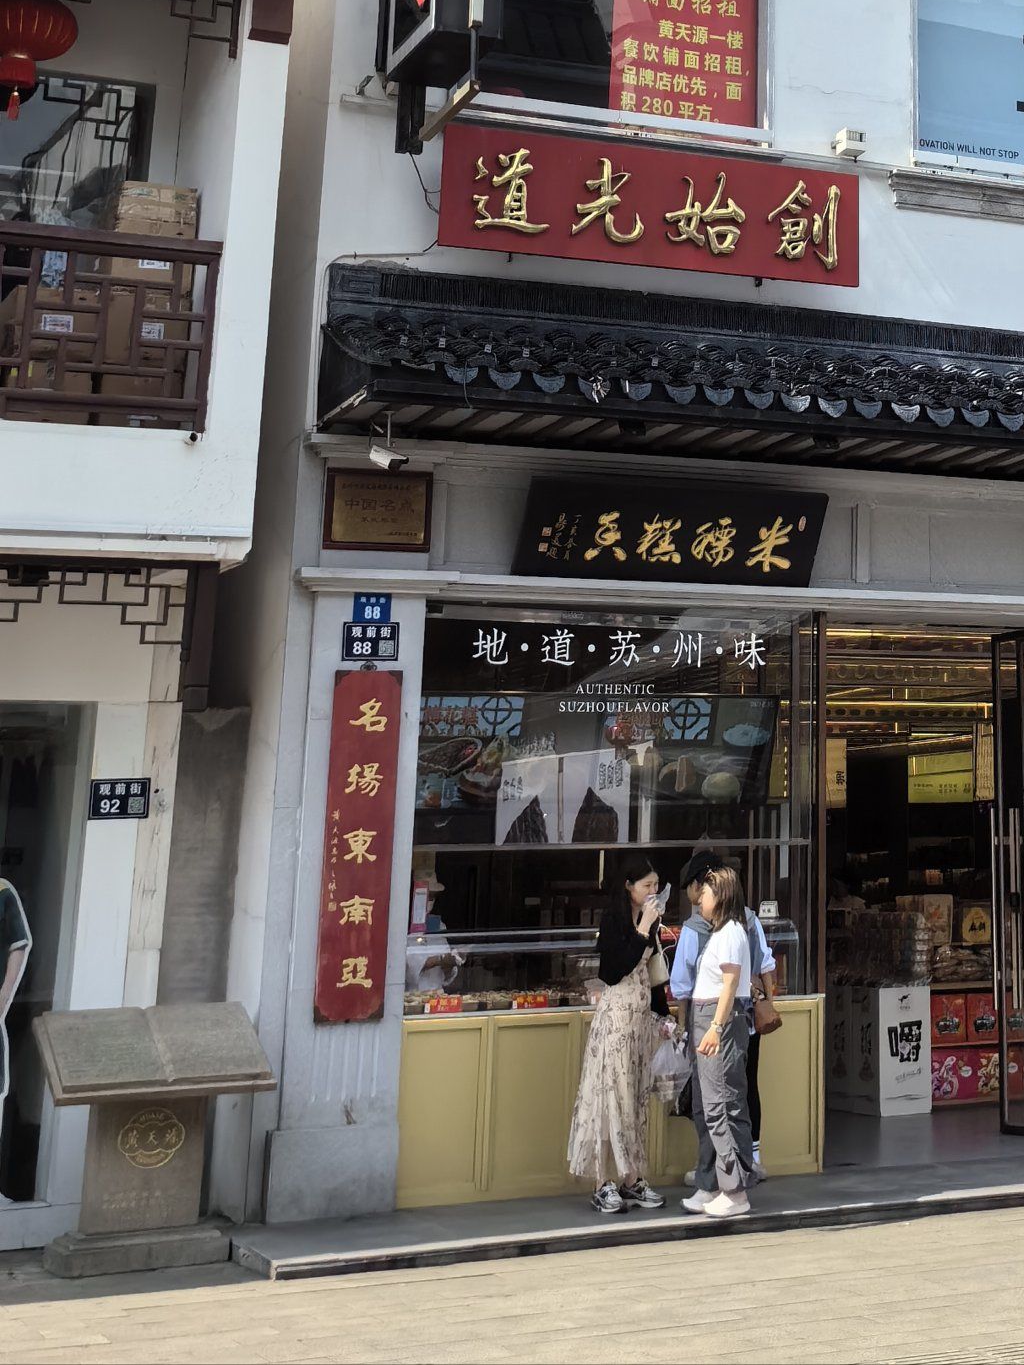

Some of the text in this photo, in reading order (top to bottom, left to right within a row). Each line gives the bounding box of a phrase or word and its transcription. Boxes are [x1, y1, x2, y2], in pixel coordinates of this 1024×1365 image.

[658, 19, 744, 50] 黄天源一楼
[956, 143, 978, 155] WILL
[979, 146, 996, 157] NOT
[997, 148, 1020, 160] STOP
[471, 147, 841, 272] 道光始創
[364, 605, 381, 619] 88
[351, 626, 392, 638] 观前街
[352, 641, 372, 655] 88
[575, 683, 656, 696] AUTHENTIC
[98, 782, 142, 795] 观前街
[100, 798, 121, 813] 92
